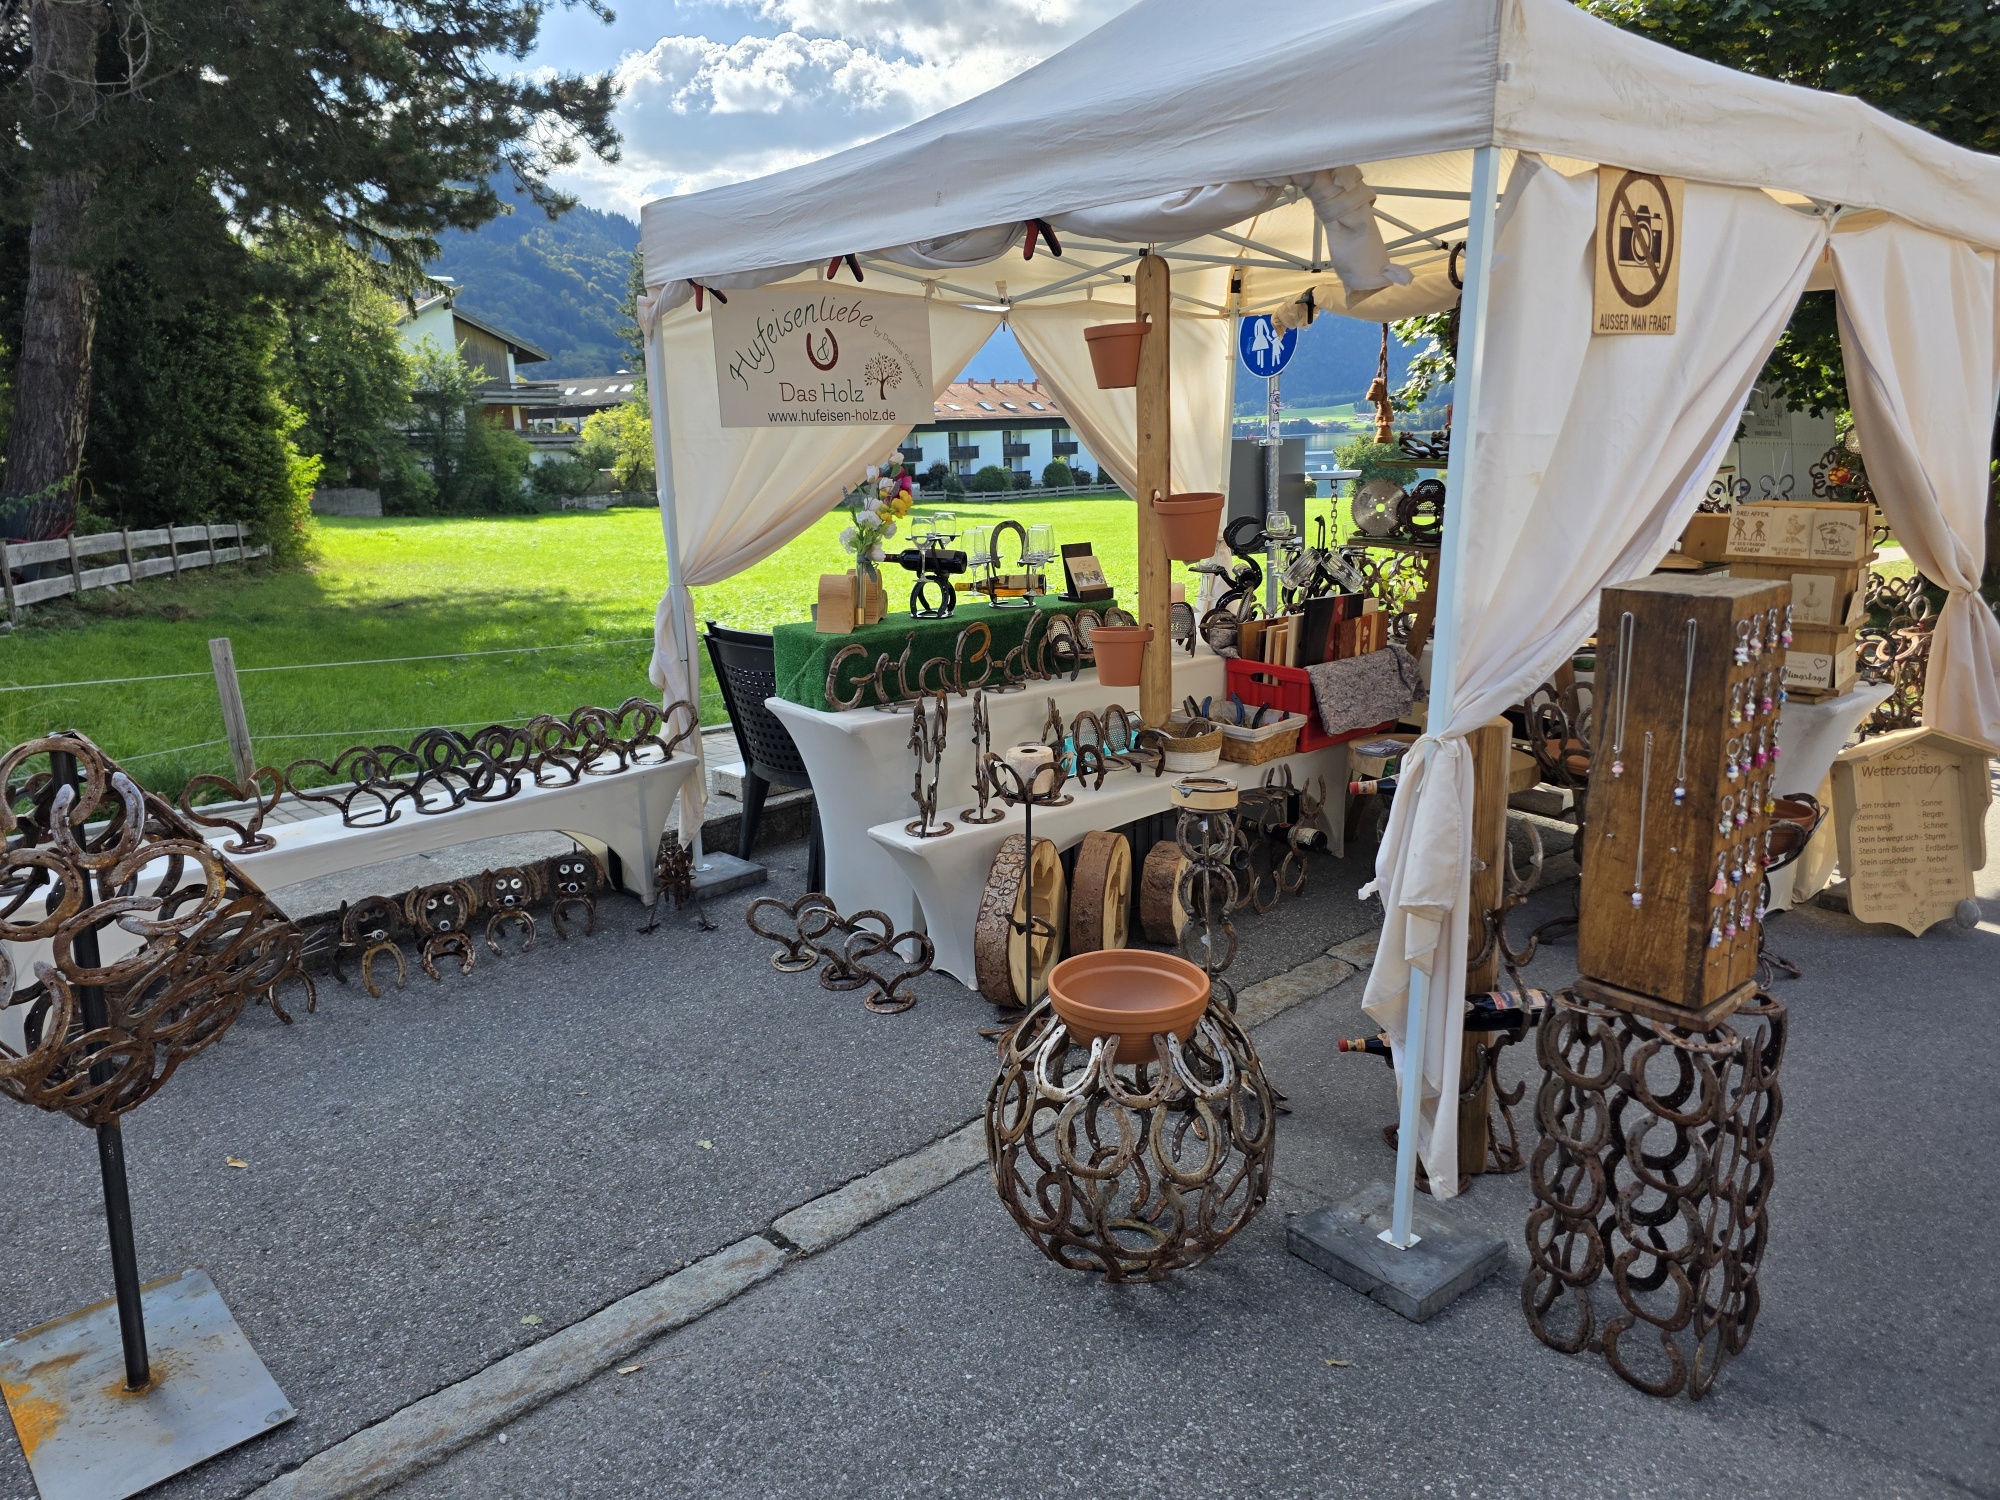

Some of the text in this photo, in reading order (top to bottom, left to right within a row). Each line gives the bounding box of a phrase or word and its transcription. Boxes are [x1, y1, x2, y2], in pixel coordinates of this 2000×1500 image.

[1599, 313, 1672, 332] AUSSER MAN FRAGT
[729, 296, 874, 391] Hufeisenliebe
[816, 336, 830, 361] &
[873, 325, 923, 388] by Dennis Schenker
[779, 379, 864, 403] Das Holz
[768, 409, 896, 423] www.hufeisen-holz.de
[1861, 763, 1941, 777] Wetterstation
[1857, 824, 1874, 832] Stein
[1876, 823, 1893, 832] weiß
[1923, 822, 1948, 830] Schnee
[1858, 836, 1875, 844] Stein
[1877, 835, 1903, 843] bewegt
[1905, 833, 1919, 841] sich
[1924, 833, 1946, 841] Sturm
[1859, 847, 1876, 855] Stein
[1892, 845, 1914, 853] Boden
[1925, 844, 1959, 852] Erdbeben
[1860, 858, 1877, 866] Stein
[1879, 856, 1917, 865] unsichtbar
[1926, 855, 1947, 863] Nebel
[1861, 870, 1878, 878] Stein
[1881, 868, 1908, 878] doppelt
[1927, 866, 1954, 874] Alkohol
[1862, 881, 1879, 890] Stein
[1930, 889, 1960, 897] Sommer
